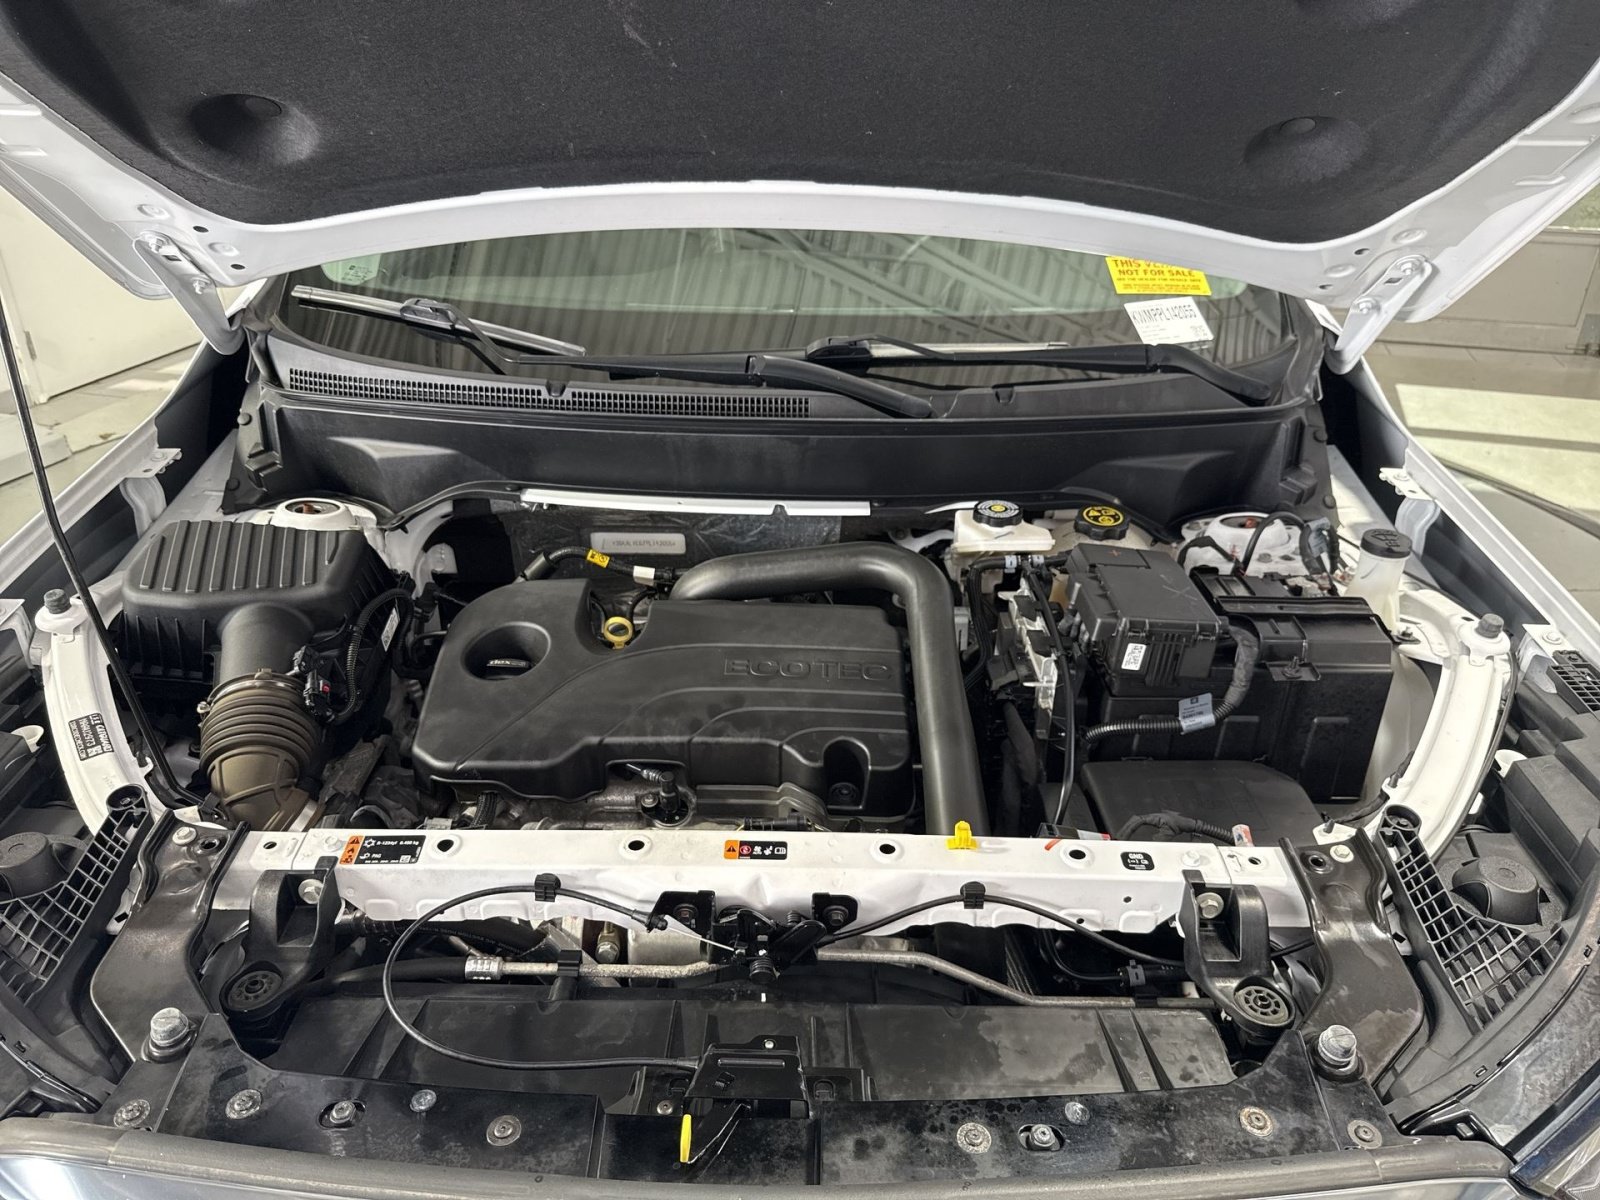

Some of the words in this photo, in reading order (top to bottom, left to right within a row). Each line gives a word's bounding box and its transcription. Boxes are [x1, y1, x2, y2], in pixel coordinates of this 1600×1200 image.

[1113, 259, 1141, 268] THIS
[1167, 269, 1196, 277] SALE
[724, 657, 893, 681] ECOTEC
